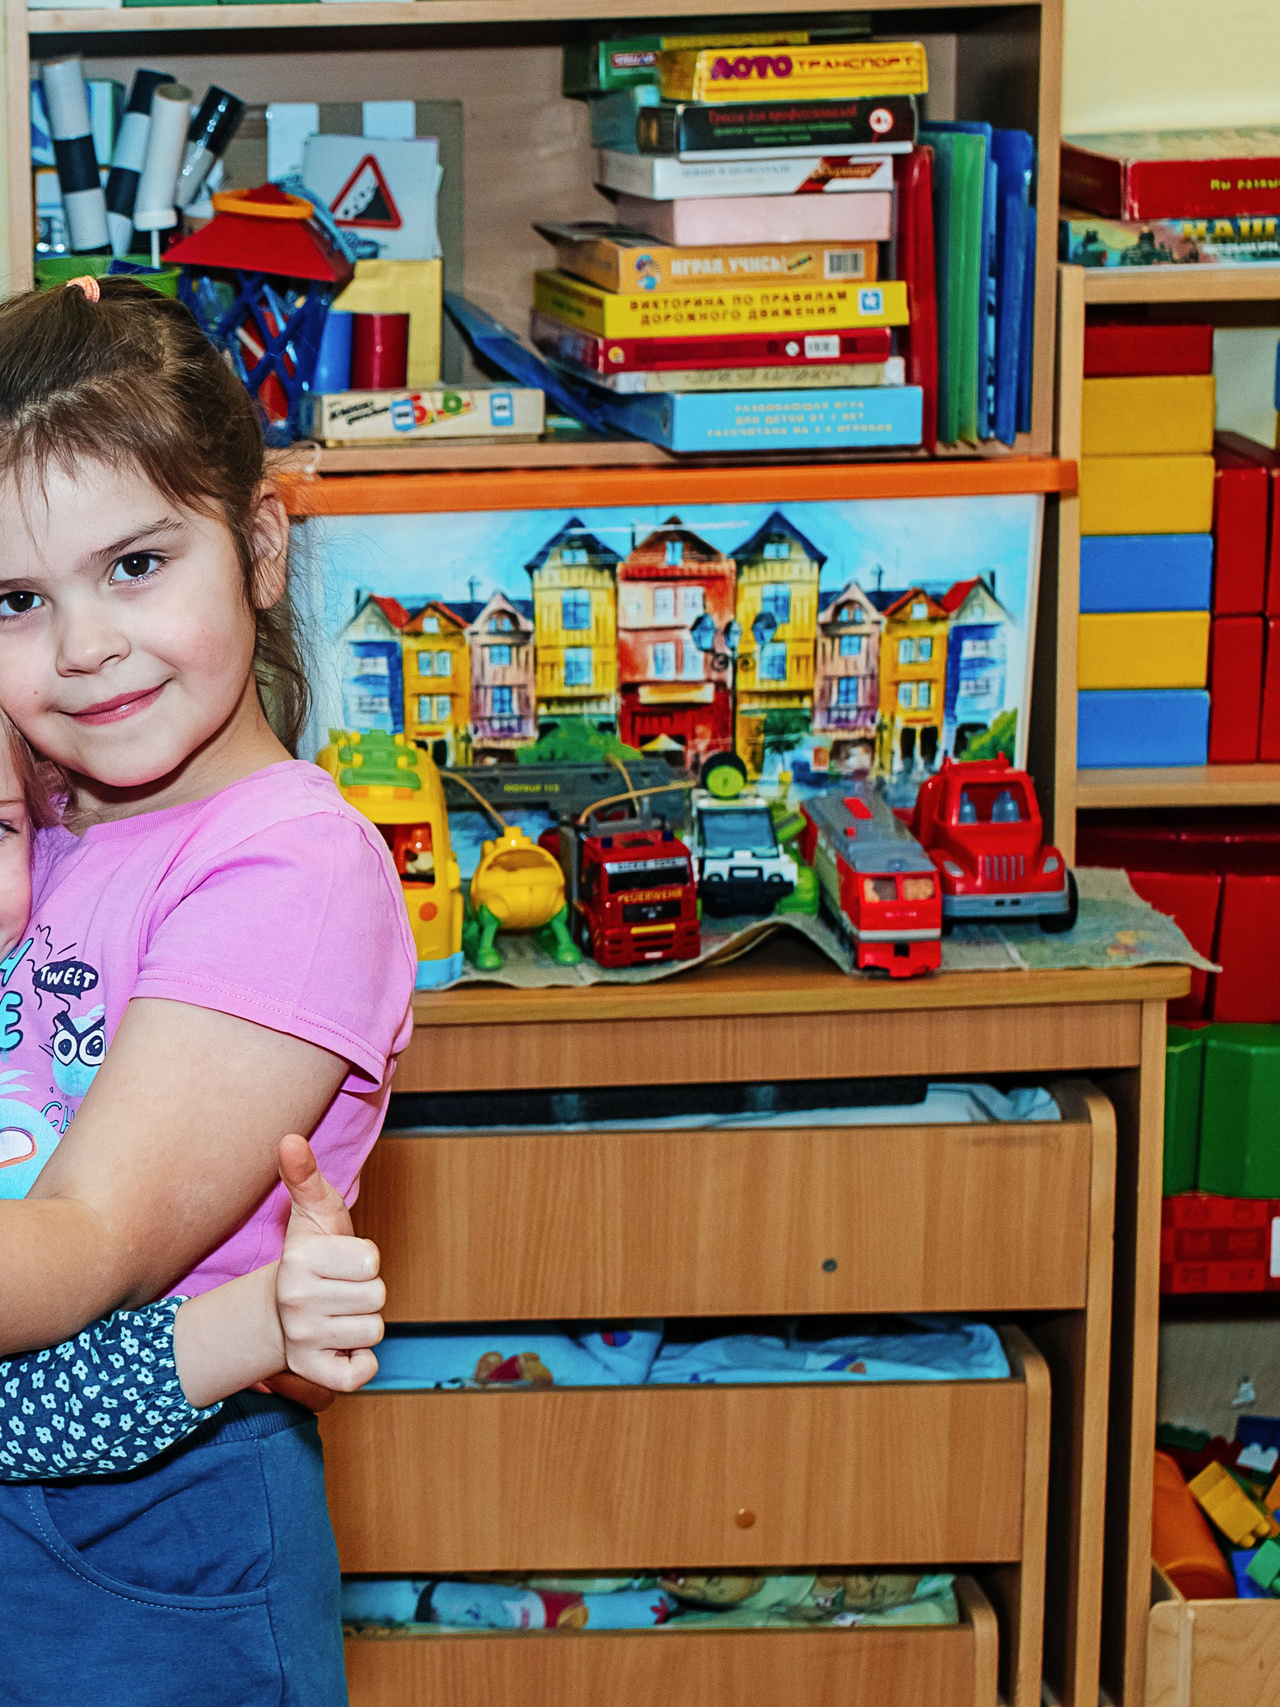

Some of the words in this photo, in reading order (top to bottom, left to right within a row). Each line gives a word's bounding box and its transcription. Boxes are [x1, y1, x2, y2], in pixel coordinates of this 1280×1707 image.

[710, 55, 793, 80] ЛОТО
[798, 57, 913, 70] ТРАНСПОРТ
[630, 297, 725, 310] ВИКТОРИНА
[732, 296, 754, 307] ПО
[761, 291, 847, 305] ПРАВИЛАМ
[640, 311, 741, 326] ДОРОЖНОГО
[748, 306, 837, 321] ДВИЖЕНИЯ
[39, 965, 97, 988] TWEET
